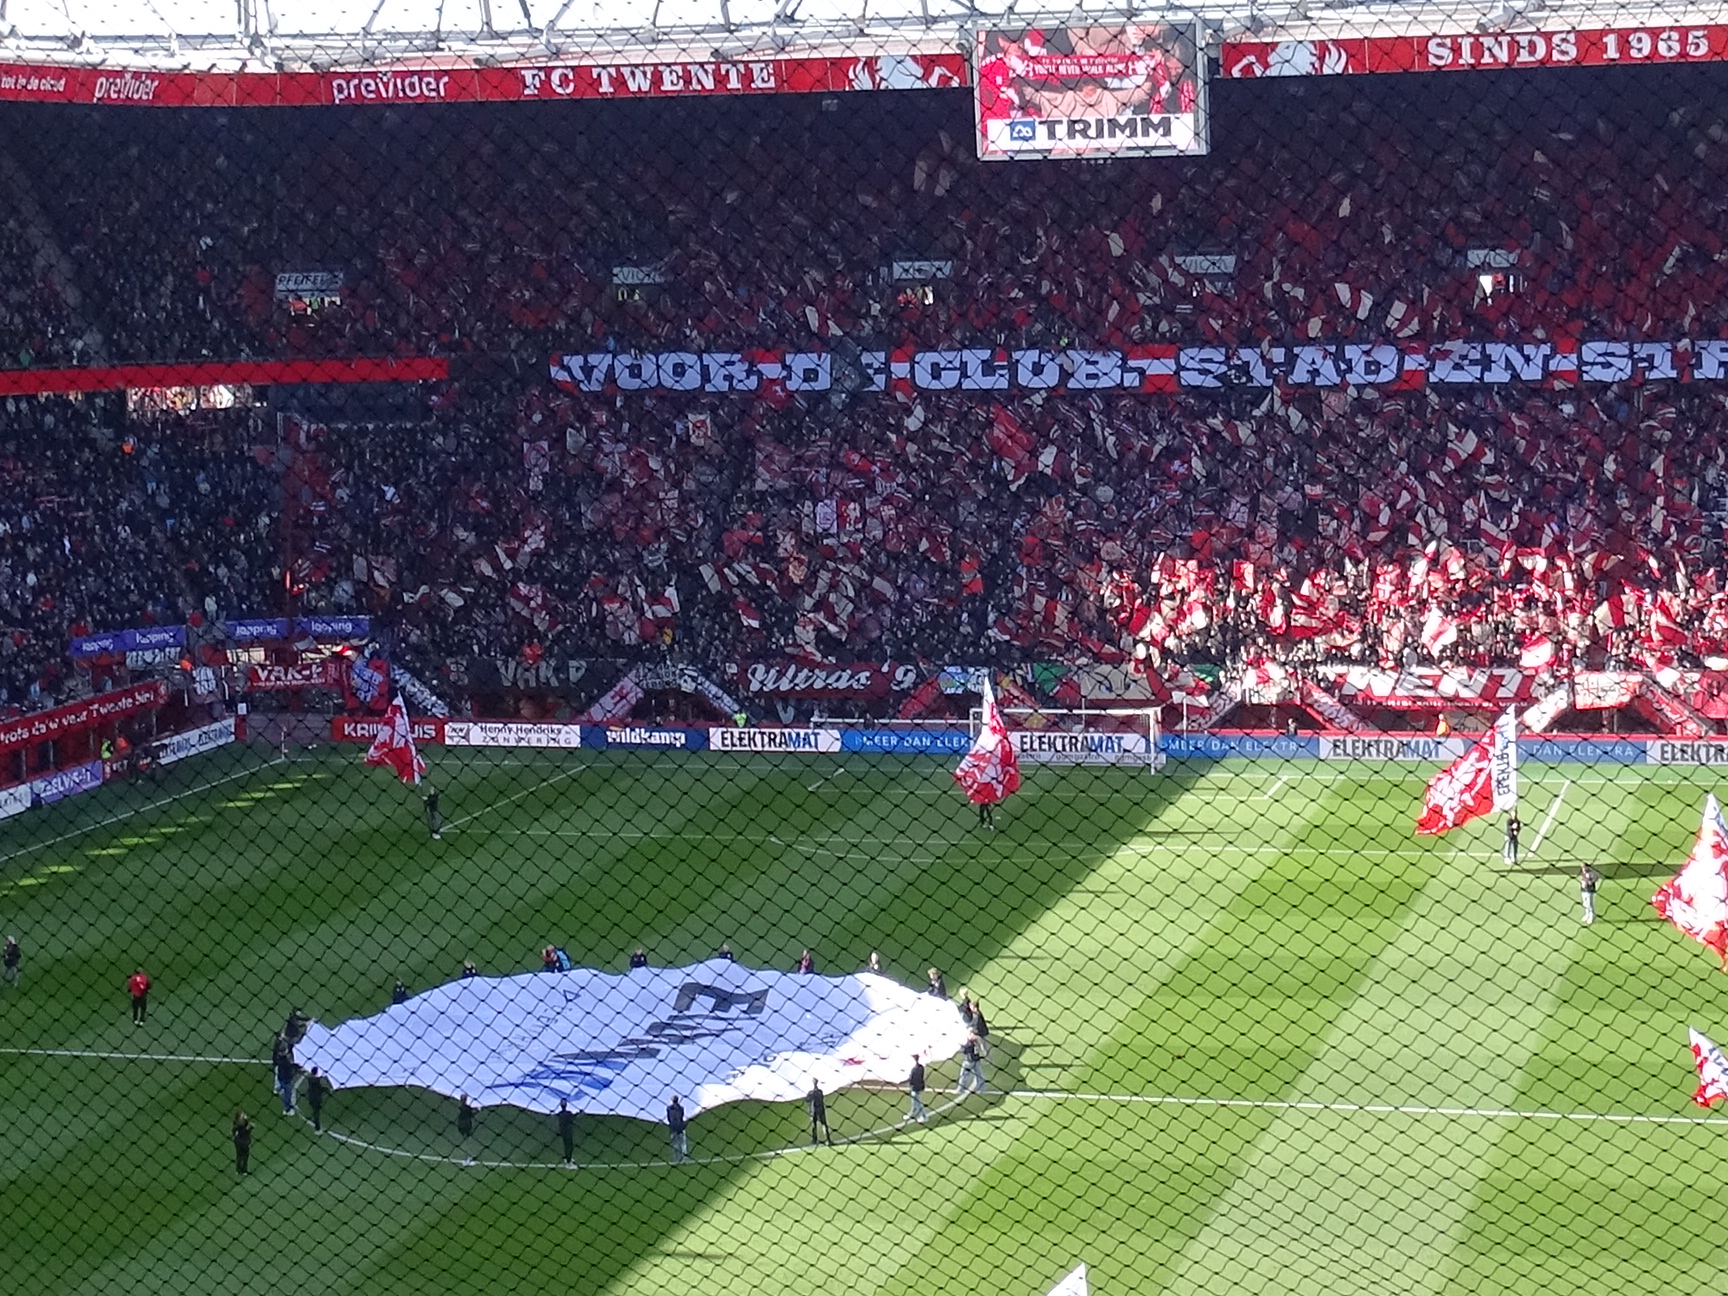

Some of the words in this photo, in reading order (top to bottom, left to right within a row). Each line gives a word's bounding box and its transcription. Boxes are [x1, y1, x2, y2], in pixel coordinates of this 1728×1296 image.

[1428, 33, 1578, 67] SINDS
[1603, 30, 1710, 59] 1965
[521, 68, 575, 96] FC
[592, 62, 775, 94] TWENTE
[1040, 116, 1171, 141] TRIMM
[563, 352, 758, 392] VOOR
[1179, 344, 1398, 388] STAD
[1428, 341, 1552, 384] EN
[605, 728, 686, 748] wildkamp
[721, 730, 821, 749] ELEKTRAMAT
[904, 736, 931, 747] DAN
[1020, 735, 1125, 753] ELEKTRAMAT
[1212, 740, 1239, 751] DAN
[1332, 738, 1440, 758] ELEKTRAMAT
